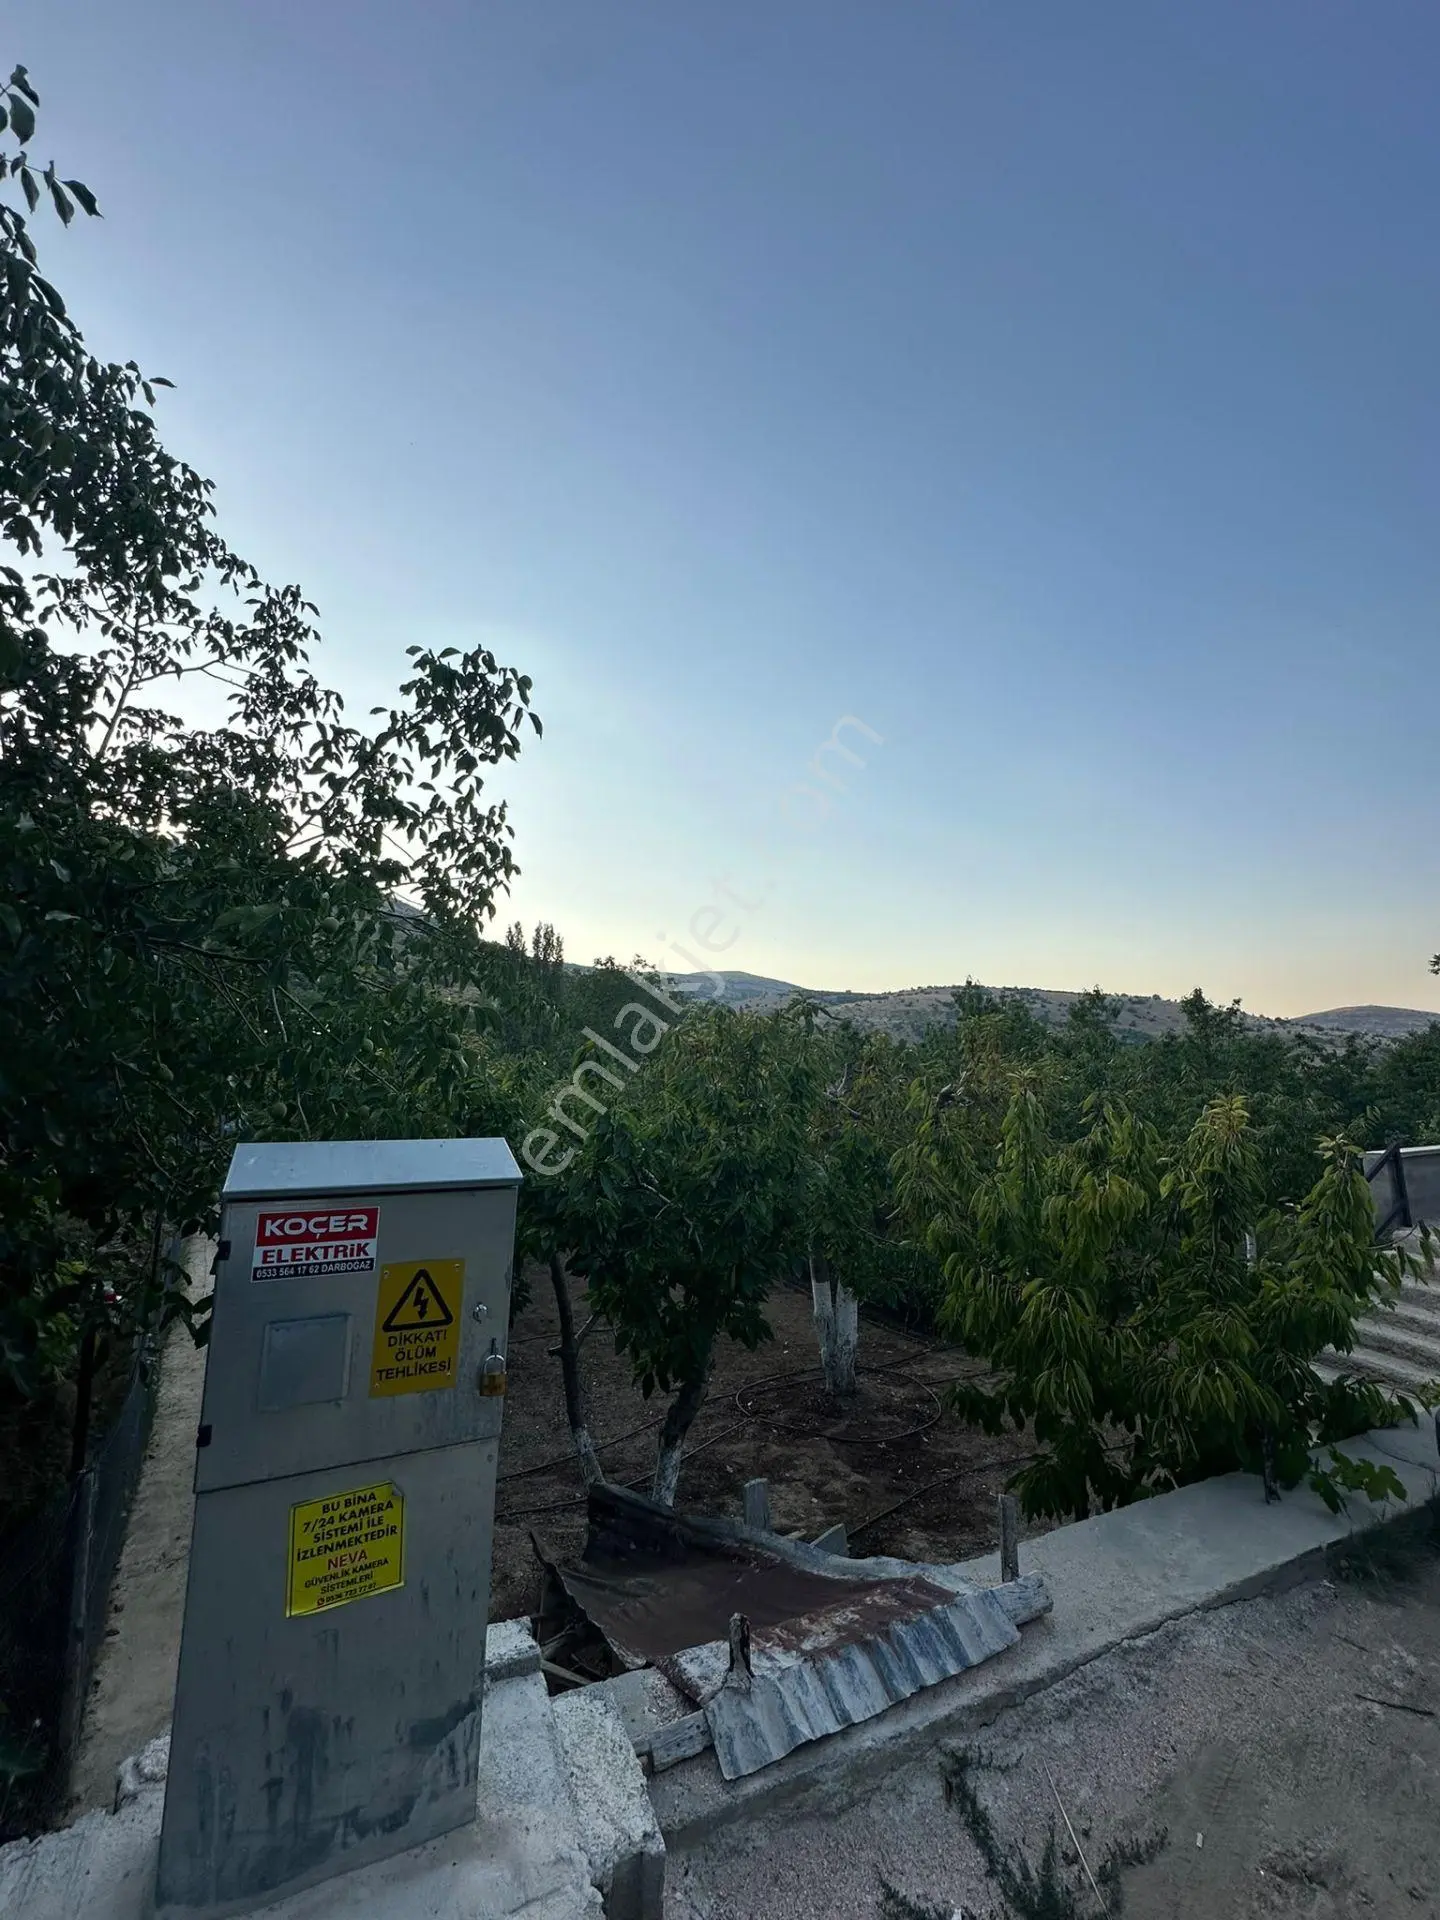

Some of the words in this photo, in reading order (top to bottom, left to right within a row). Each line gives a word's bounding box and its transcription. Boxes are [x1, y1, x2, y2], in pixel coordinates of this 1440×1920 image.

[265, 1214, 368, 1239] KOÇER
[256, 1267, 277, 1278] 0533
[280, 1266, 294, 1276] 564
[297, 1265, 306, 1275] 17
[394, 1346, 436, 1362] ÖLÜM
[376, 1357, 451, 1381] TEHLİKESİ
[303, 1518, 335, 1533] 7/24
[339, 1500, 394, 1523] KAMERA
[322, 1501, 340, 1514] BU
[297, 1524, 398, 1562] İZLENMEKTEDİR
[327, 1549, 367, 1570] NEVA
[352, 1558, 389, 1574] KAMERA
